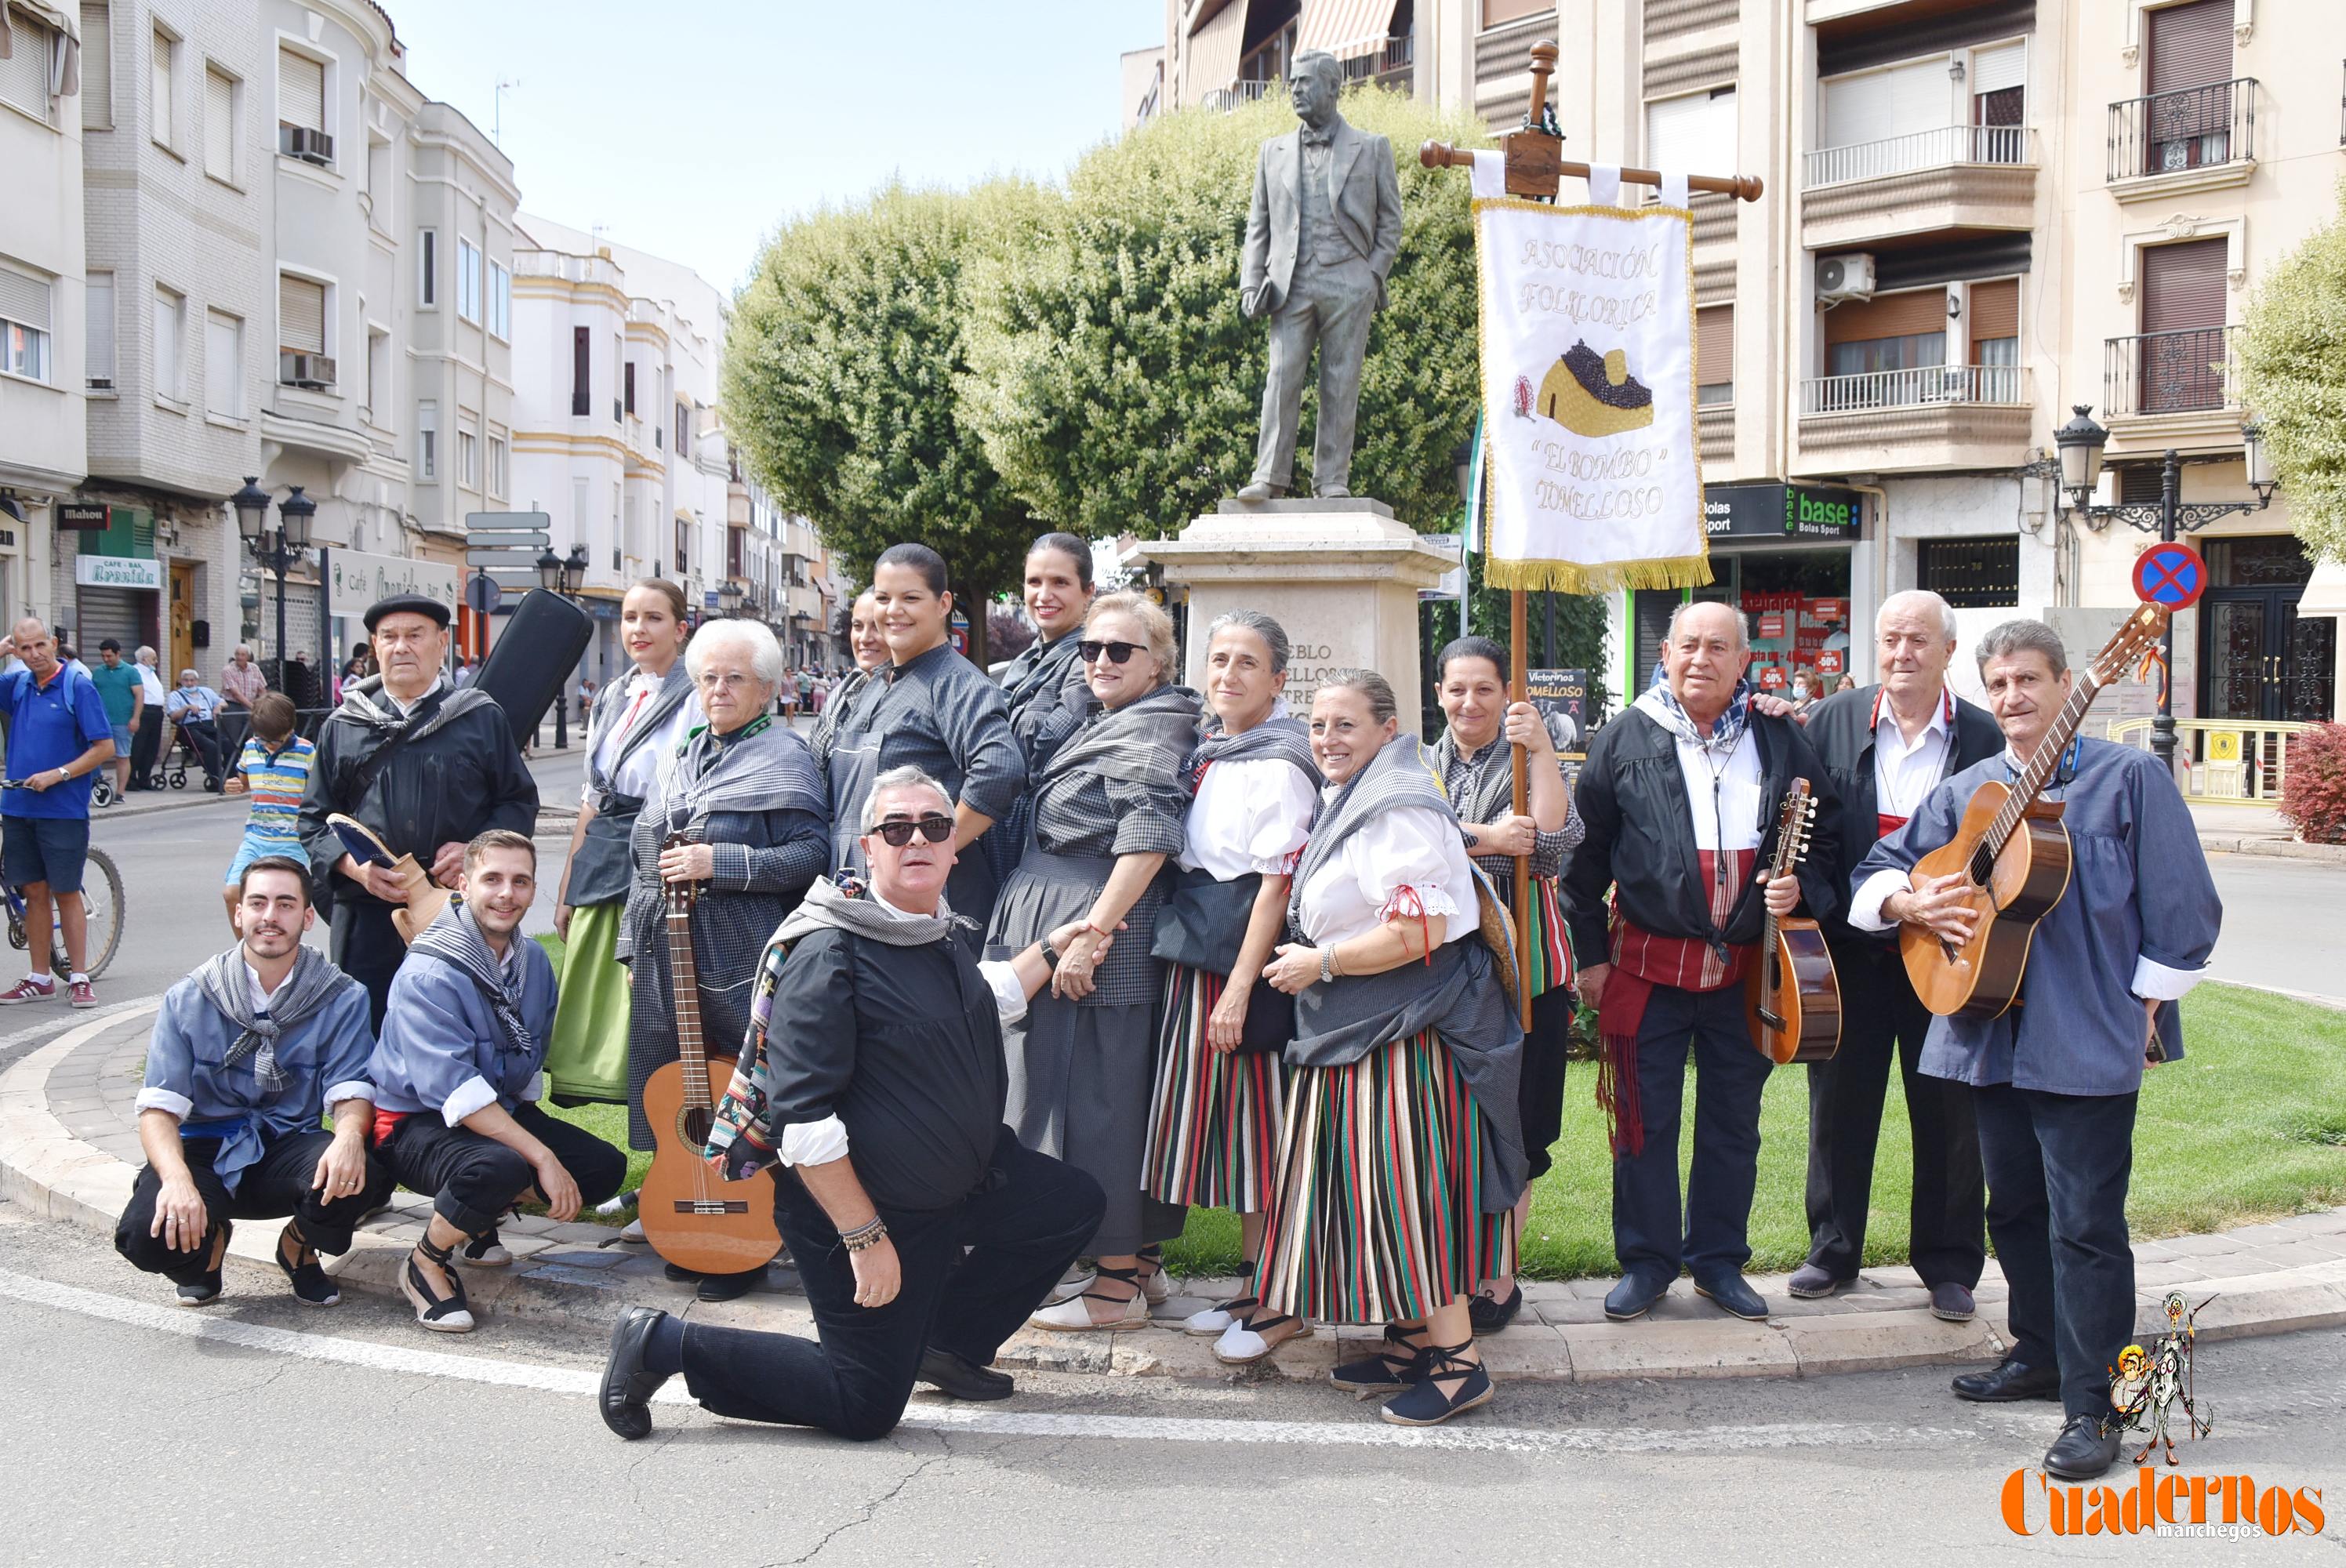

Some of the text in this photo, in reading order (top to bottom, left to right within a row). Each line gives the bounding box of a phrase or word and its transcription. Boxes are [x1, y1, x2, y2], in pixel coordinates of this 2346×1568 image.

[1521, 238, 1659, 280] ASOCIACIÓN
[1520, 283, 1657, 332] FOLKLORICA
[1534, 480, 1664, 521] TOMELLOSO
[64, 509, 104, 520] Mahou
[1799, 522, 1840, 535] Bolas Sport
[93, 564, 154, 585] Avenida
[1287, 644, 1331, 659] EBLO
[1818, 656, 1838, 667] -50%
[1527, 671, 1574, 682] Victorinos
[1763, 673, 1782, 684] -50%
[1526, 685, 1583, 698] OMELLOSO
